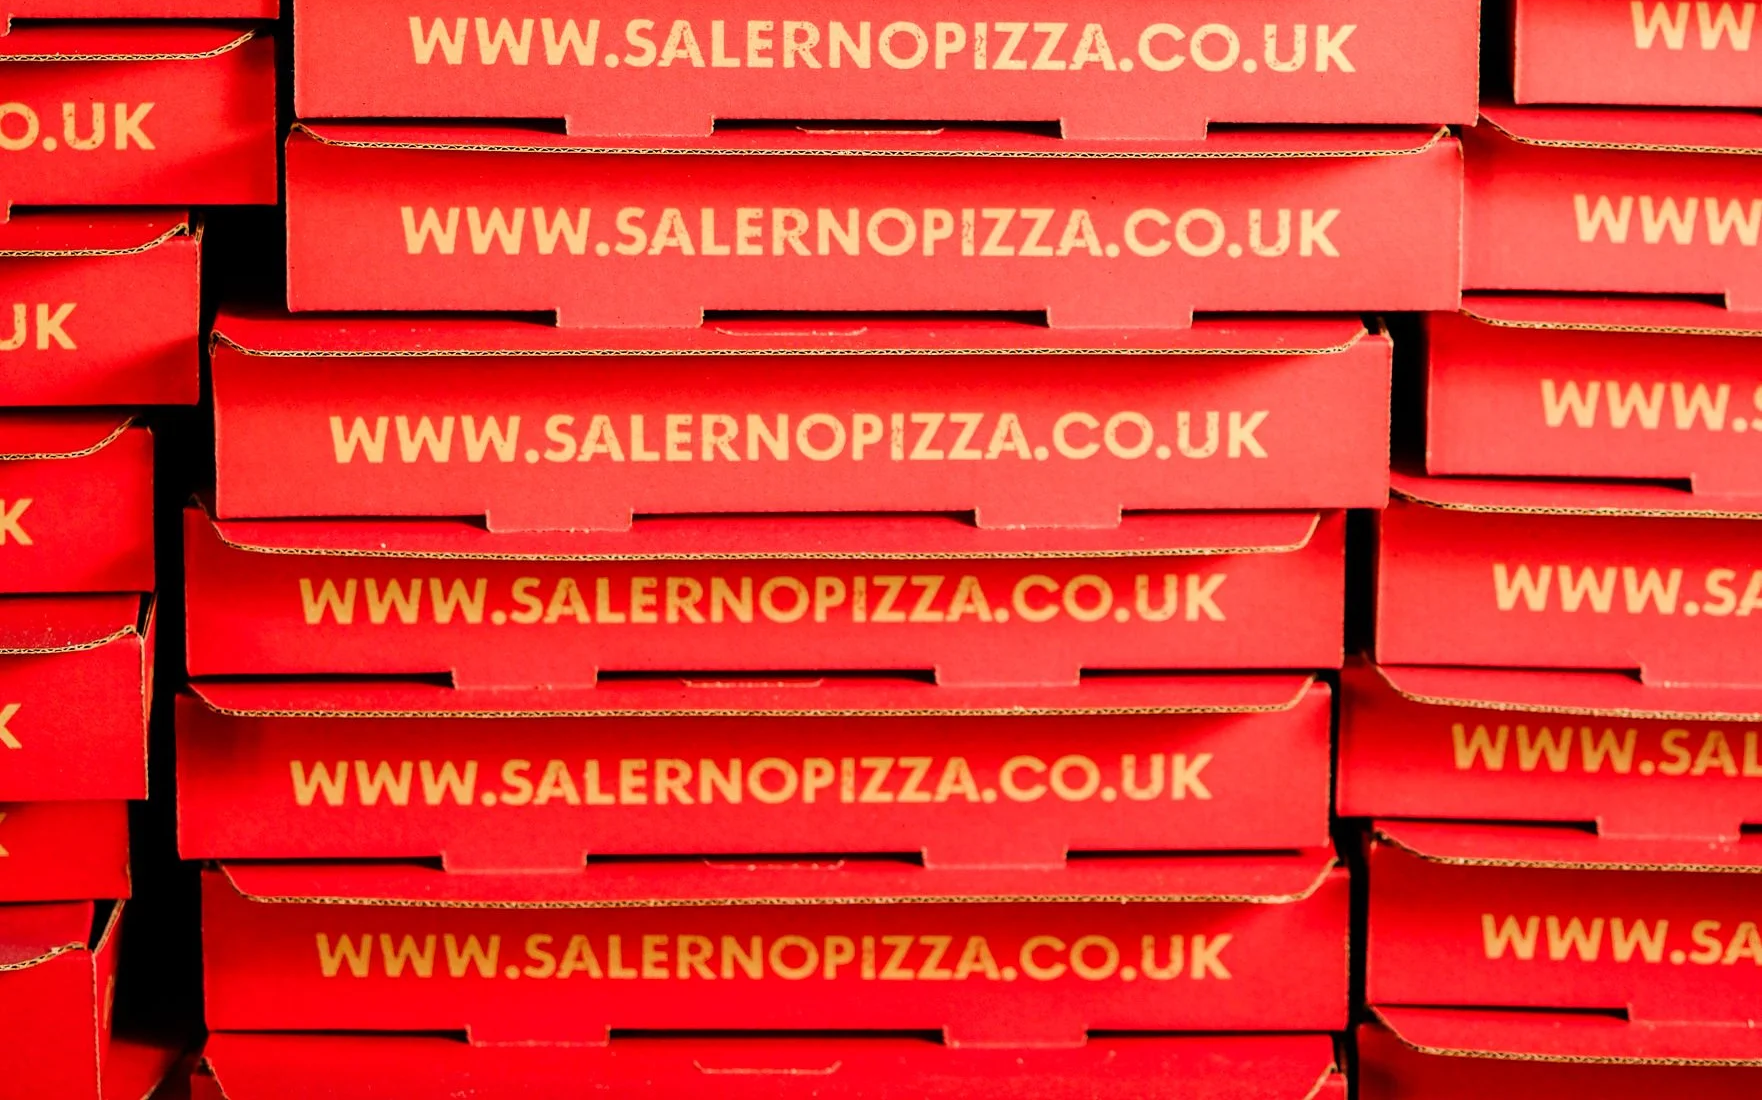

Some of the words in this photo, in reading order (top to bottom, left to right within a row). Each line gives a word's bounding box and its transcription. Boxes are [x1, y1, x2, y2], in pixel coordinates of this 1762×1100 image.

[410, 17, 1355, 71] WWW.SALERNOPIZZA.CO.UK
[1631, 1, 1762, 48] WW
[0, 102, 154, 150] O.UK
[401, 206, 1338, 256] WWW.SALERNOPIZZA.CO.UK
[1574, 195, 1762, 244] WWW
[330, 412, 1266, 463] WWW.SALERNOPIZZA.CO.UK
[300, 574, 1224, 624] WWW.SALERNOPIZZA.CO.UK
[291, 753, 1211, 805] WWW.SALERNOPIZZA.CO.UK
[318, 934, 1229, 980] WWW.SALERNOPIZZA.CO.UK
[1483, 915, 1762, 964] WWW.SA
